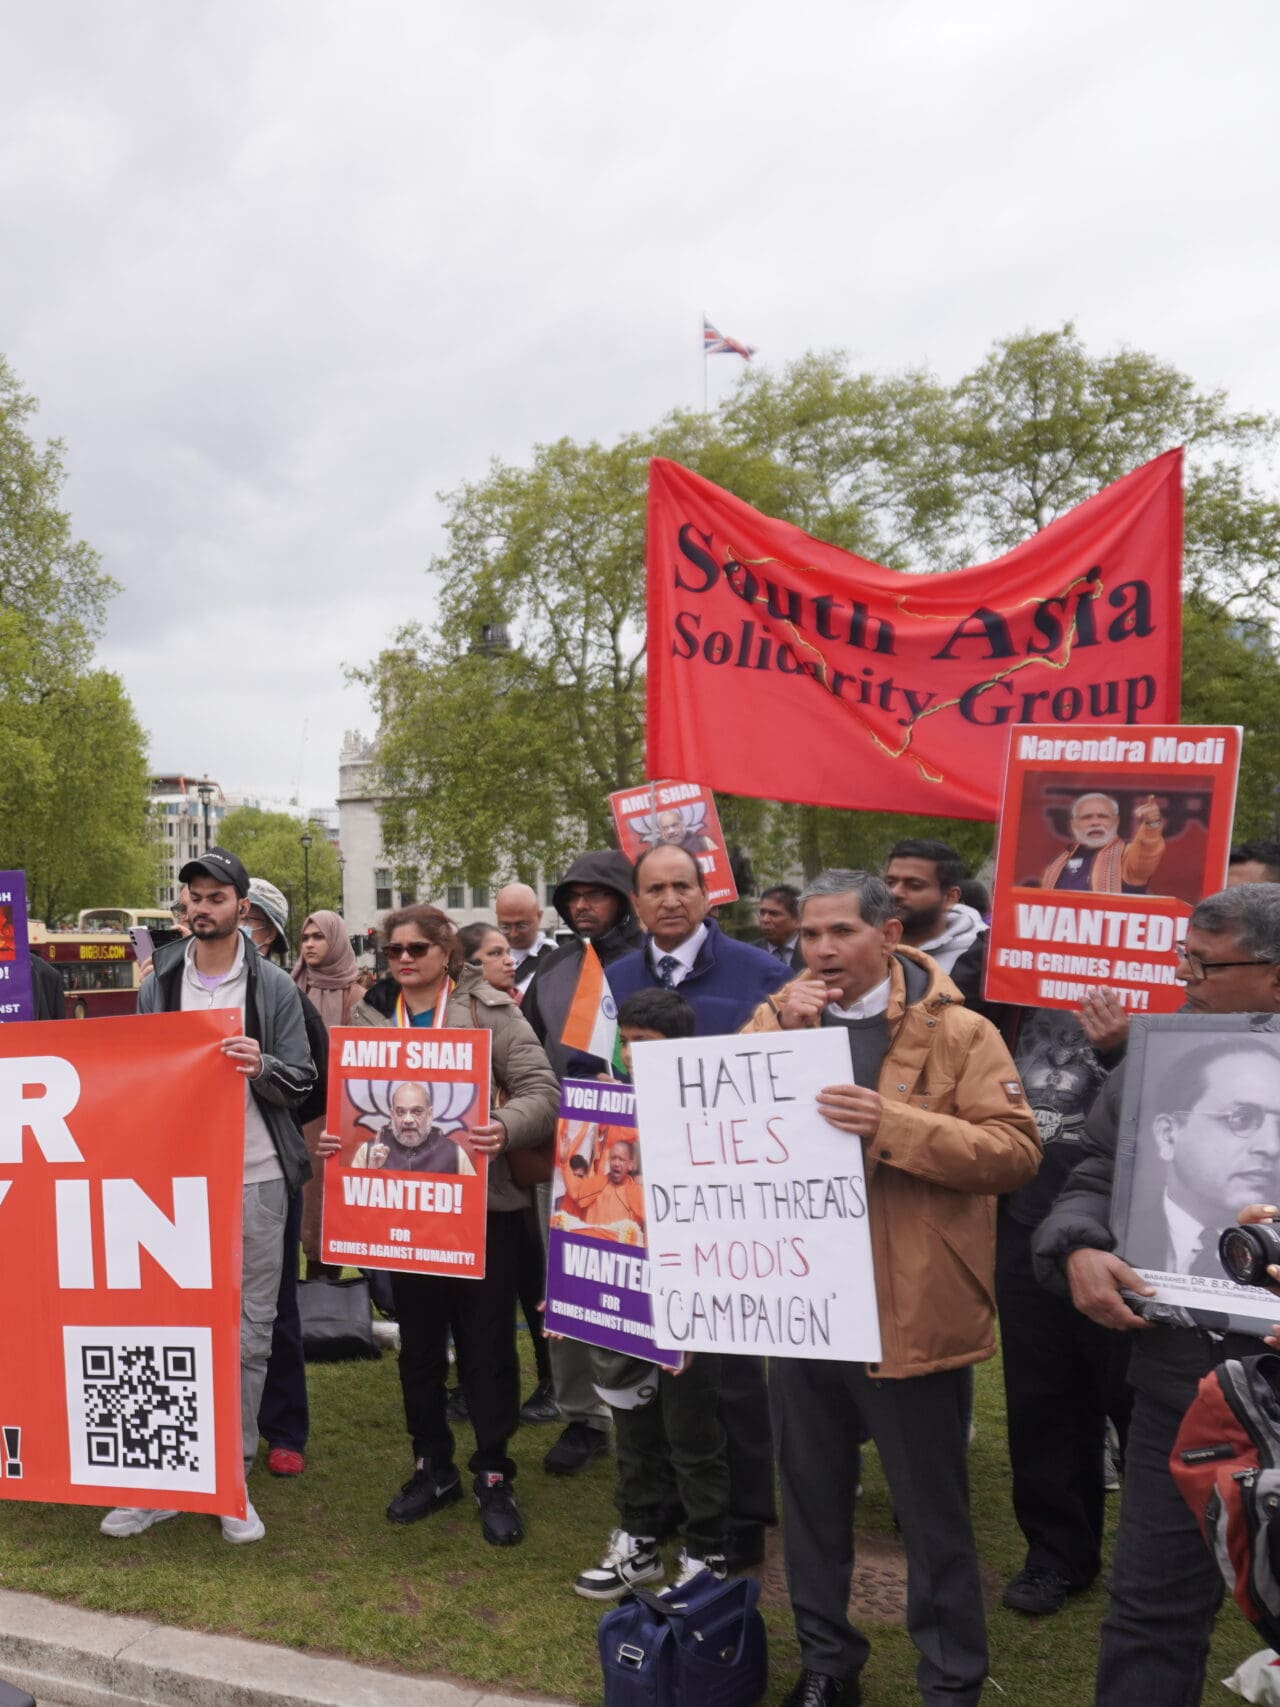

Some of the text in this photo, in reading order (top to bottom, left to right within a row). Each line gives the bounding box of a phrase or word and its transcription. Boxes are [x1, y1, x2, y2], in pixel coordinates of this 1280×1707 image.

[675, 521, 1157, 660] South Asia
[959, 673, 1157, 725] Group
[1019, 735, 1226, 764] Narendra Modi
[658, 783, 702, 805] SHAH
[1016, 903, 1190, 953] WANTED!
[79, 944, 126, 959] BIGBUS.COM
[998, 948, 1034, 970] FOR
[1036, 953, 1111, 978] CRIMES
[339, 1040, 474, 1071] AMIT SHAH
[677, 1050, 797, 1109] HATE
[565, 1086, 599, 1111] YOGI
[685, 1116, 790, 1166] LIES
[342, 1176, 464, 1215] WANTED!
[650, 1175, 867, 1224] DEATH THREATS
[54, 1176, 214, 1290] IN
[389, 1227, 411, 1242] FOR
[328, 1239, 476, 1266] CRIMES AGAINST HUMANITY!
[693, 1237, 811, 1281] MODI'S
[551, 1299, 584, 1321] CRIMES
[584, 1308, 623, 1331] AGAINST
[601, 1293, 621, 1312] FOR
